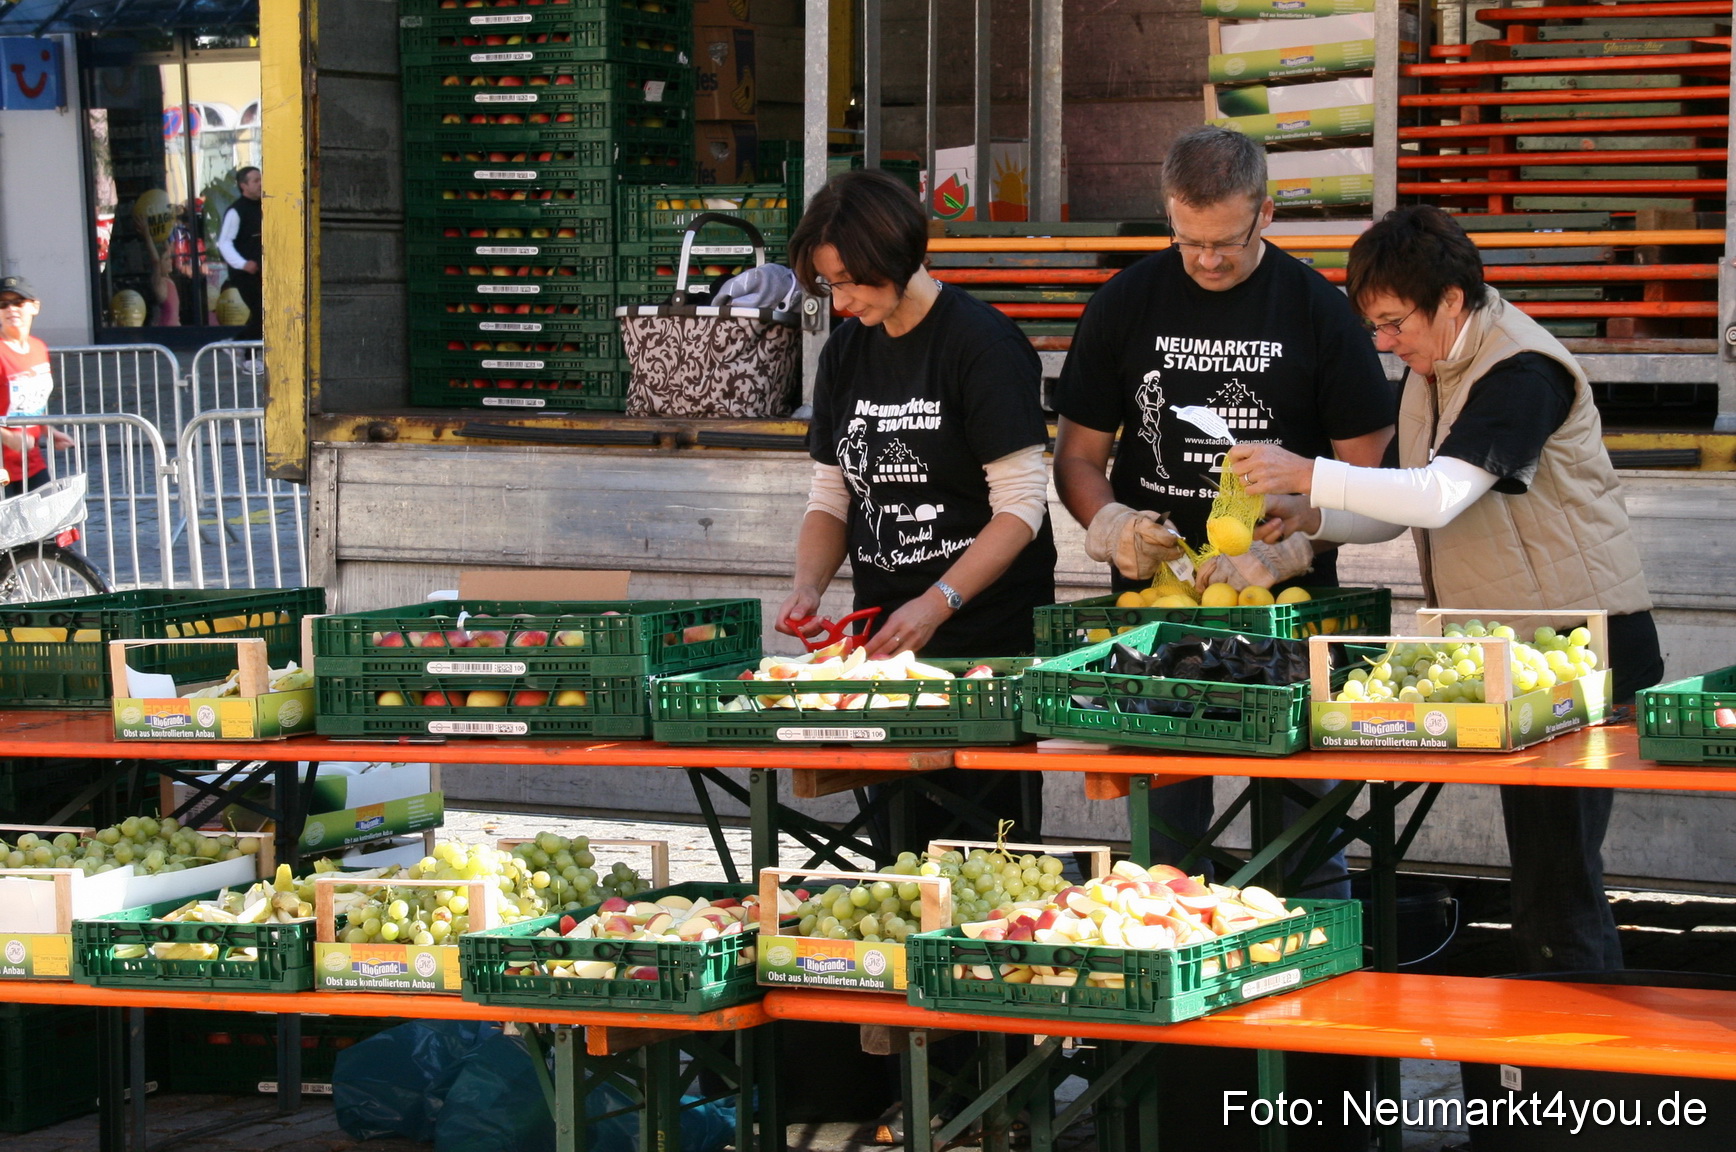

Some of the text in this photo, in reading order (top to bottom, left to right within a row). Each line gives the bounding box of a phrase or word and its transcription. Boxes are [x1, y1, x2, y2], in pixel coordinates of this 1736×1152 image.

[1155, 336, 1283, 357] NEUMARKTER
[1163, 354, 1271, 372] STADTLAUF
[855, 397, 941, 417] Neumarkter
[876, 416, 941, 432] STADTLAUF
[1140, 477, 1165, 494] Danke
[1168, 486, 1196, 498] Euer
[899, 524, 933, 546] Danke!
[123, 729, 215, 739] Obst aus kontrolliertem Anbau
[1363, 721, 1405, 734] RioGrande
[1322, 736, 1342, 746] Obst
[1343, 738, 1358, 746] aus
[1420, 737, 1447, 748] Anbau
[3, 966, 25, 975] Anbau
[362, 963, 398, 974] RioGrande
[807, 959, 845, 971] RioGrande
[326, 977, 343, 986] Obst
[360, 978, 410, 988] kontrolliertem
[412, 979, 436, 989] Anbau
[768, 971, 884, 988] Obst aus kontrolliertem Anbau
